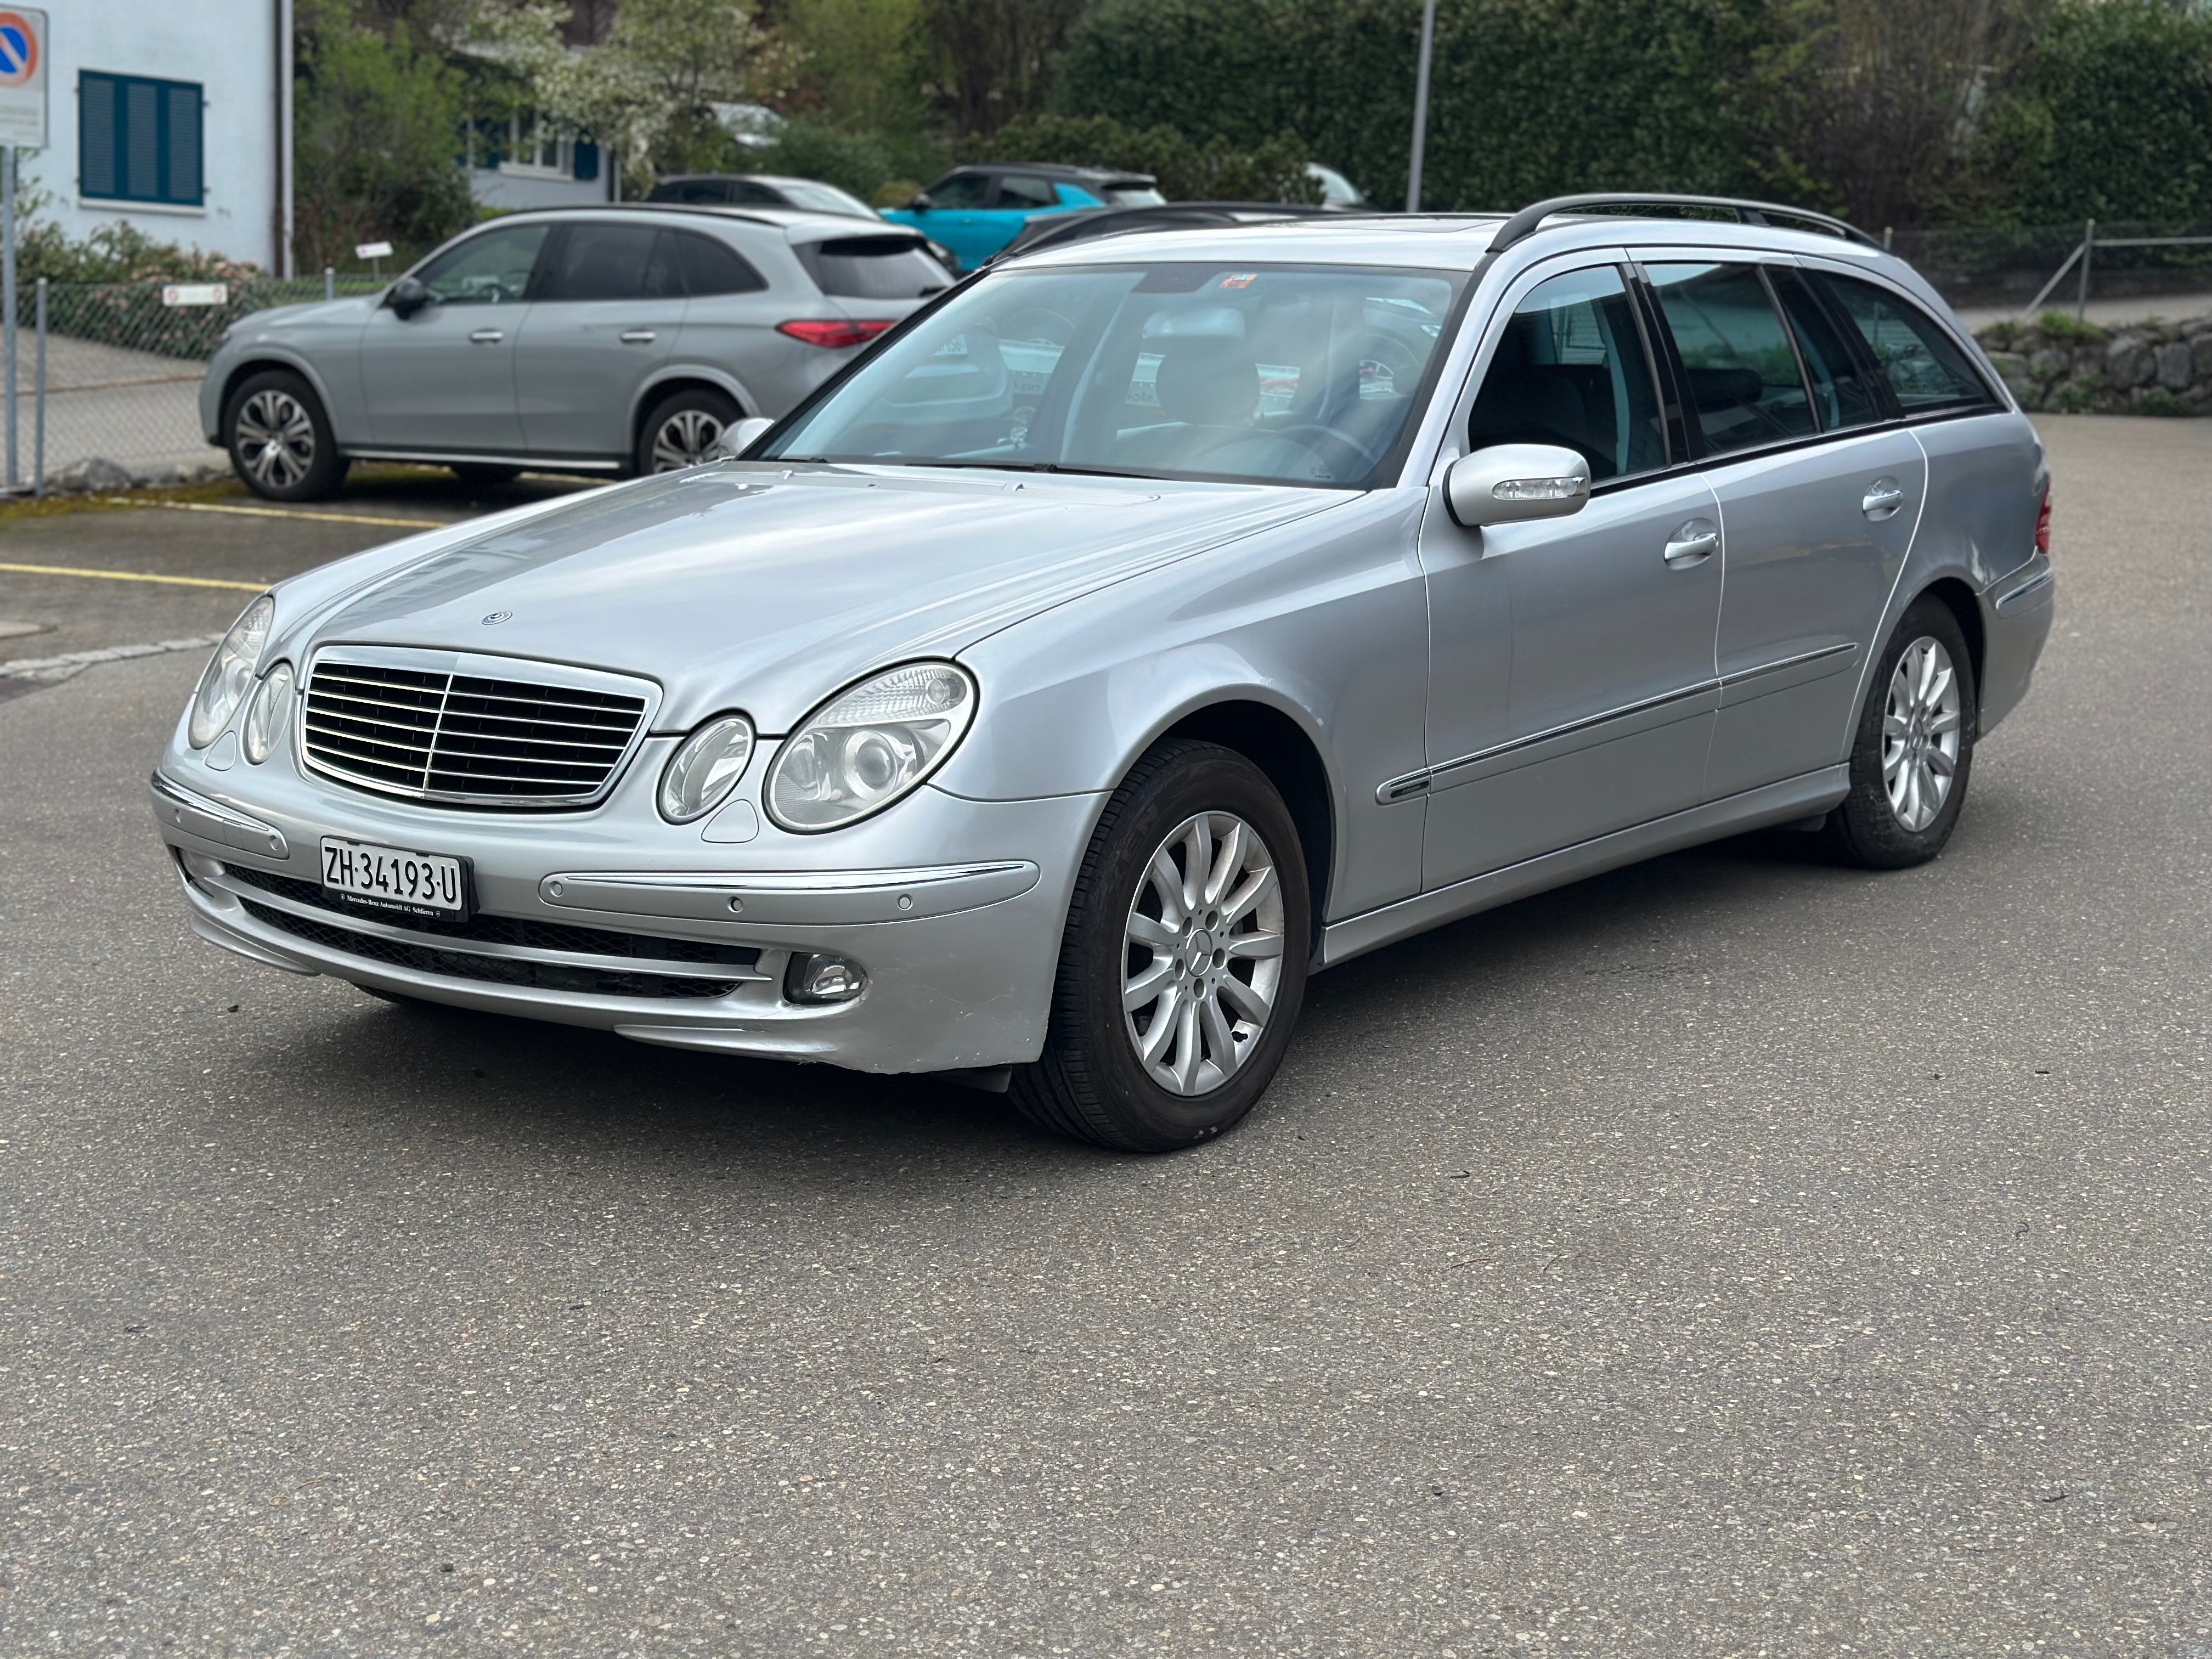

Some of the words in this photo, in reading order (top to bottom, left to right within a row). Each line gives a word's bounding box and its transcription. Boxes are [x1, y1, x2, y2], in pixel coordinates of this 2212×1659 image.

[347, 895, 379, 907] Mercedes-Benz
[380, 901, 402, 911] Automobil
[413, 907, 433, 916] Schlieren
